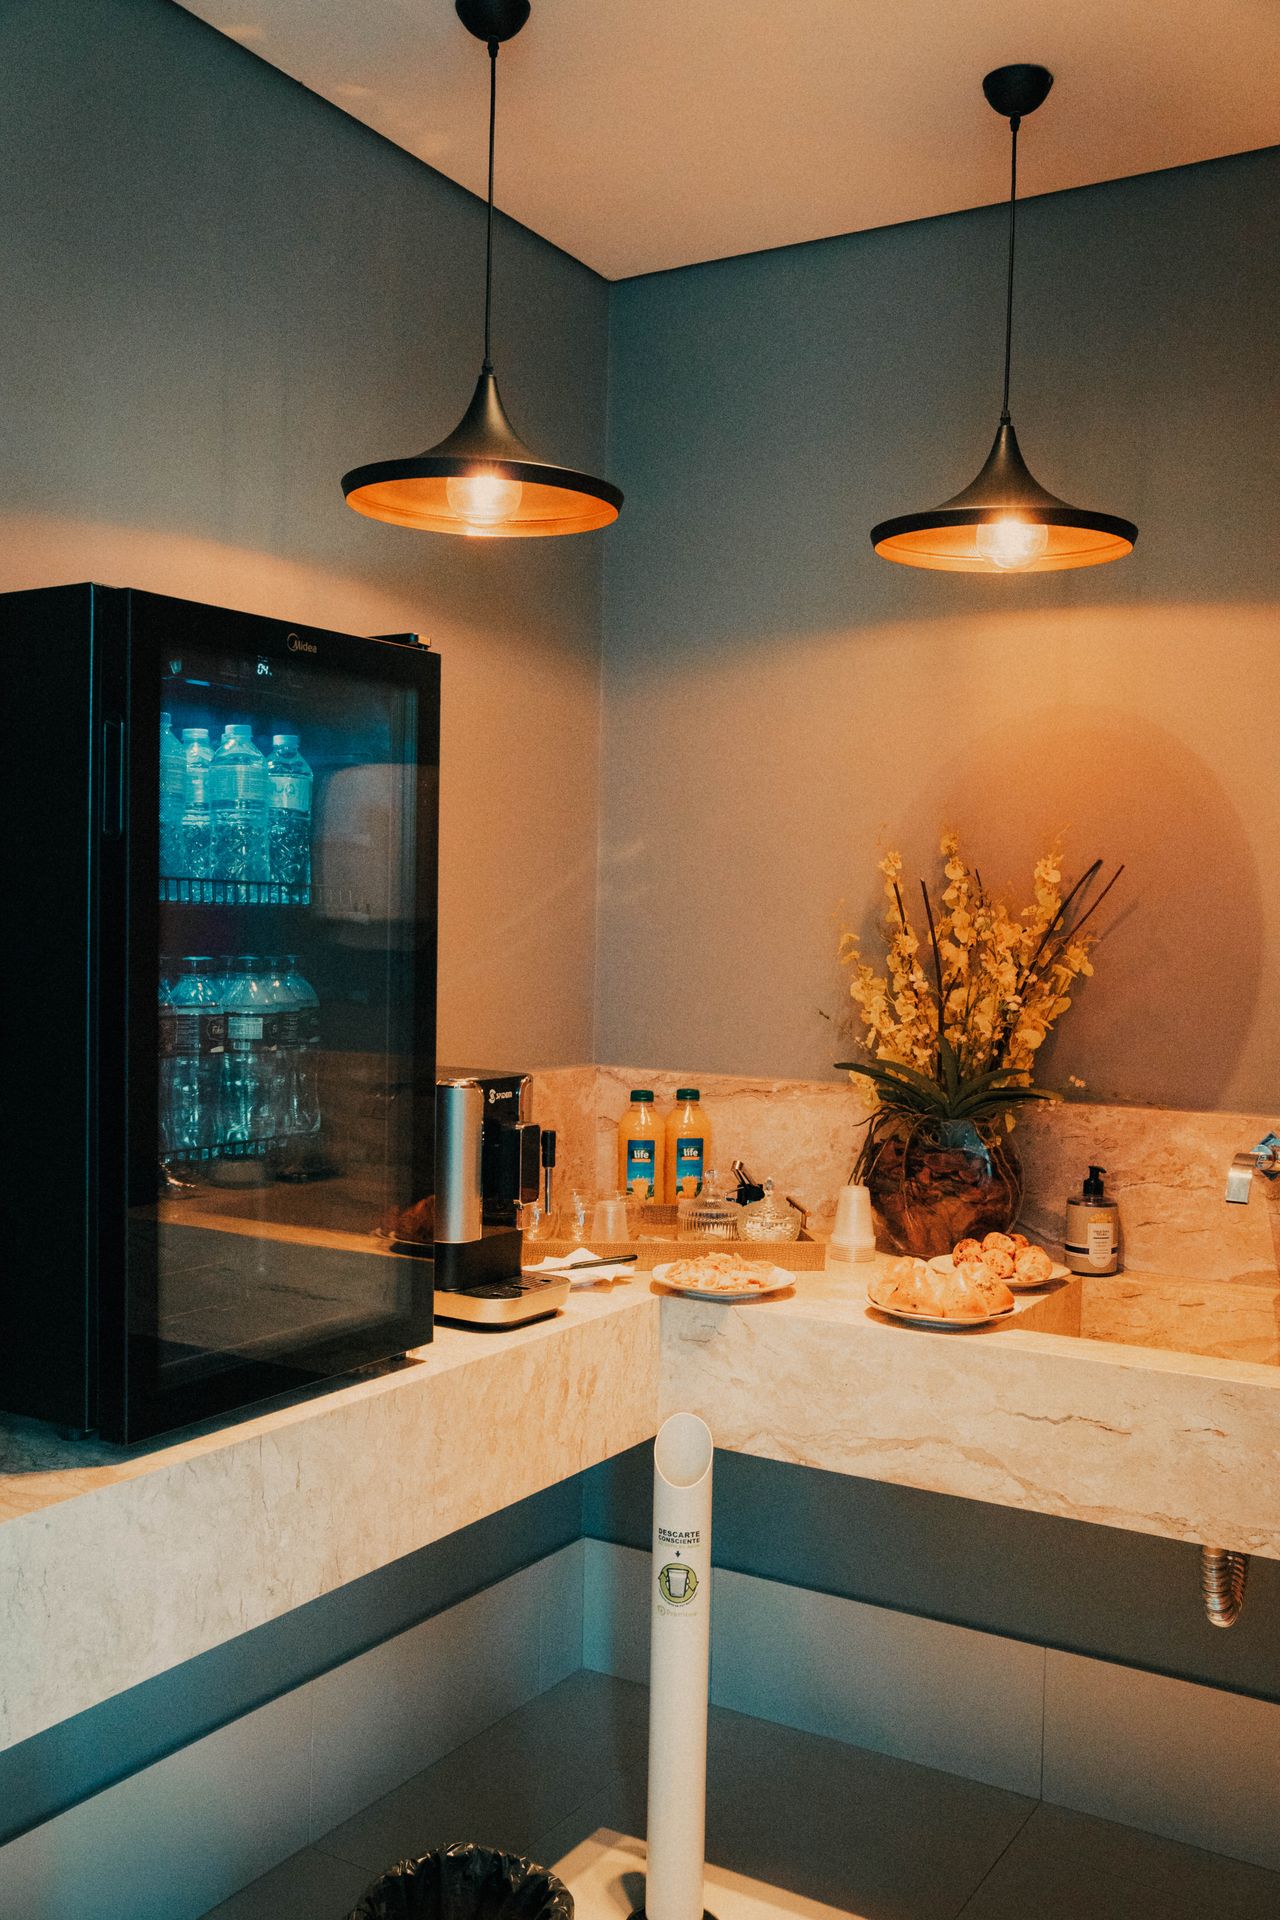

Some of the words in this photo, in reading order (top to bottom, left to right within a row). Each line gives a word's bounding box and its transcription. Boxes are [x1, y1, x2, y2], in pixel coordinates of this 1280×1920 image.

[291, 637, 318, 654] Midea
[633, 1149, 649, 1159] life
[683, 1147, 699, 1157] life
[658, 1527, 700, 1538] DESCARTE
[658, 1535, 700, 1545] CONSCIENTE
